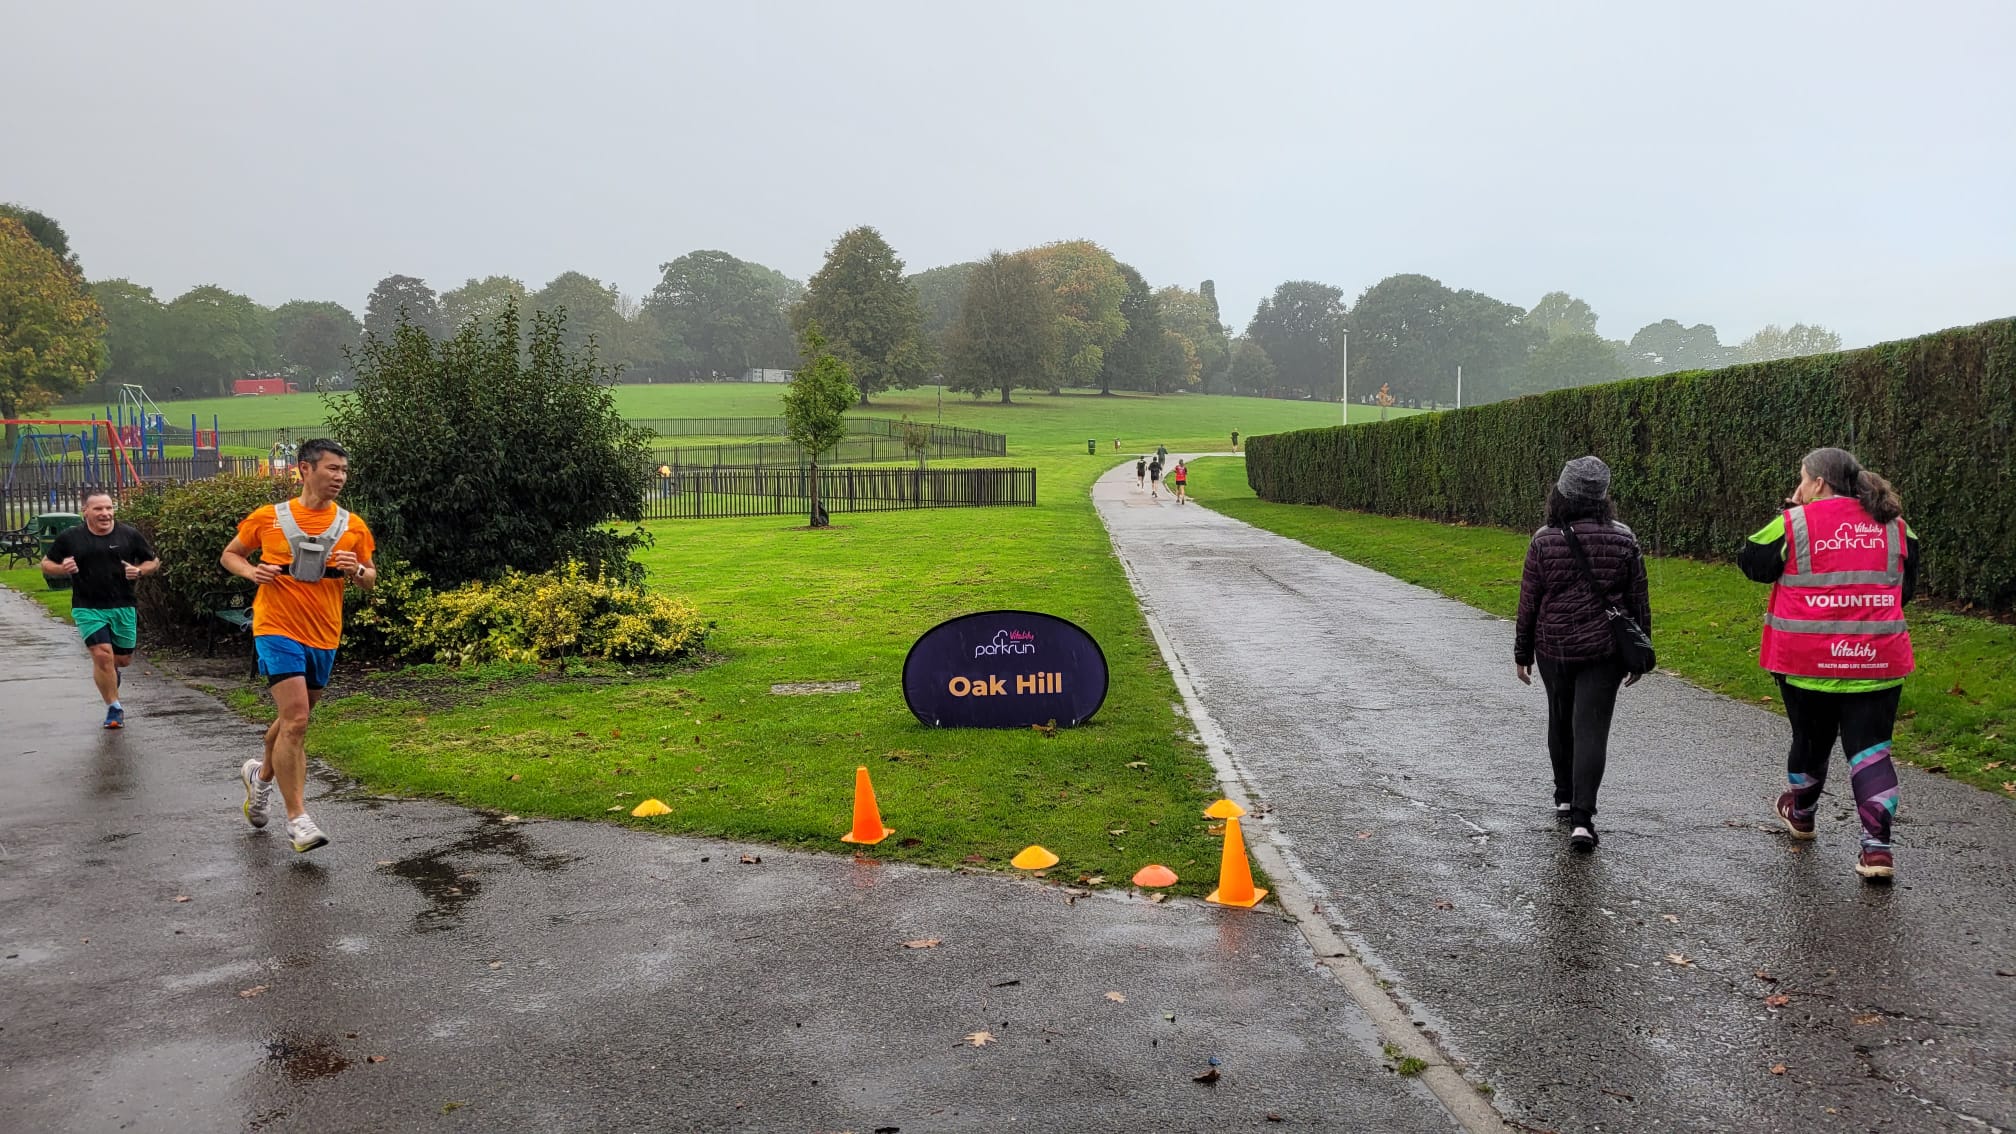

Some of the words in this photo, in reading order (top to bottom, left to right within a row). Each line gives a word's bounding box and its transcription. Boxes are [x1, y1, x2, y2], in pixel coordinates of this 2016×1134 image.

[1854, 521, 1884, 536] Vitality
[1814, 530, 1885, 555] parkrun
[1804, 594, 1896, 609] VOLUNTEER
[974, 638, 1036, 659] parkrun
[1830, 639, 1877, 662] Vitality
[948, 674, 1008, 697] Oak
[1016, 672, 1063, 695] Hill
